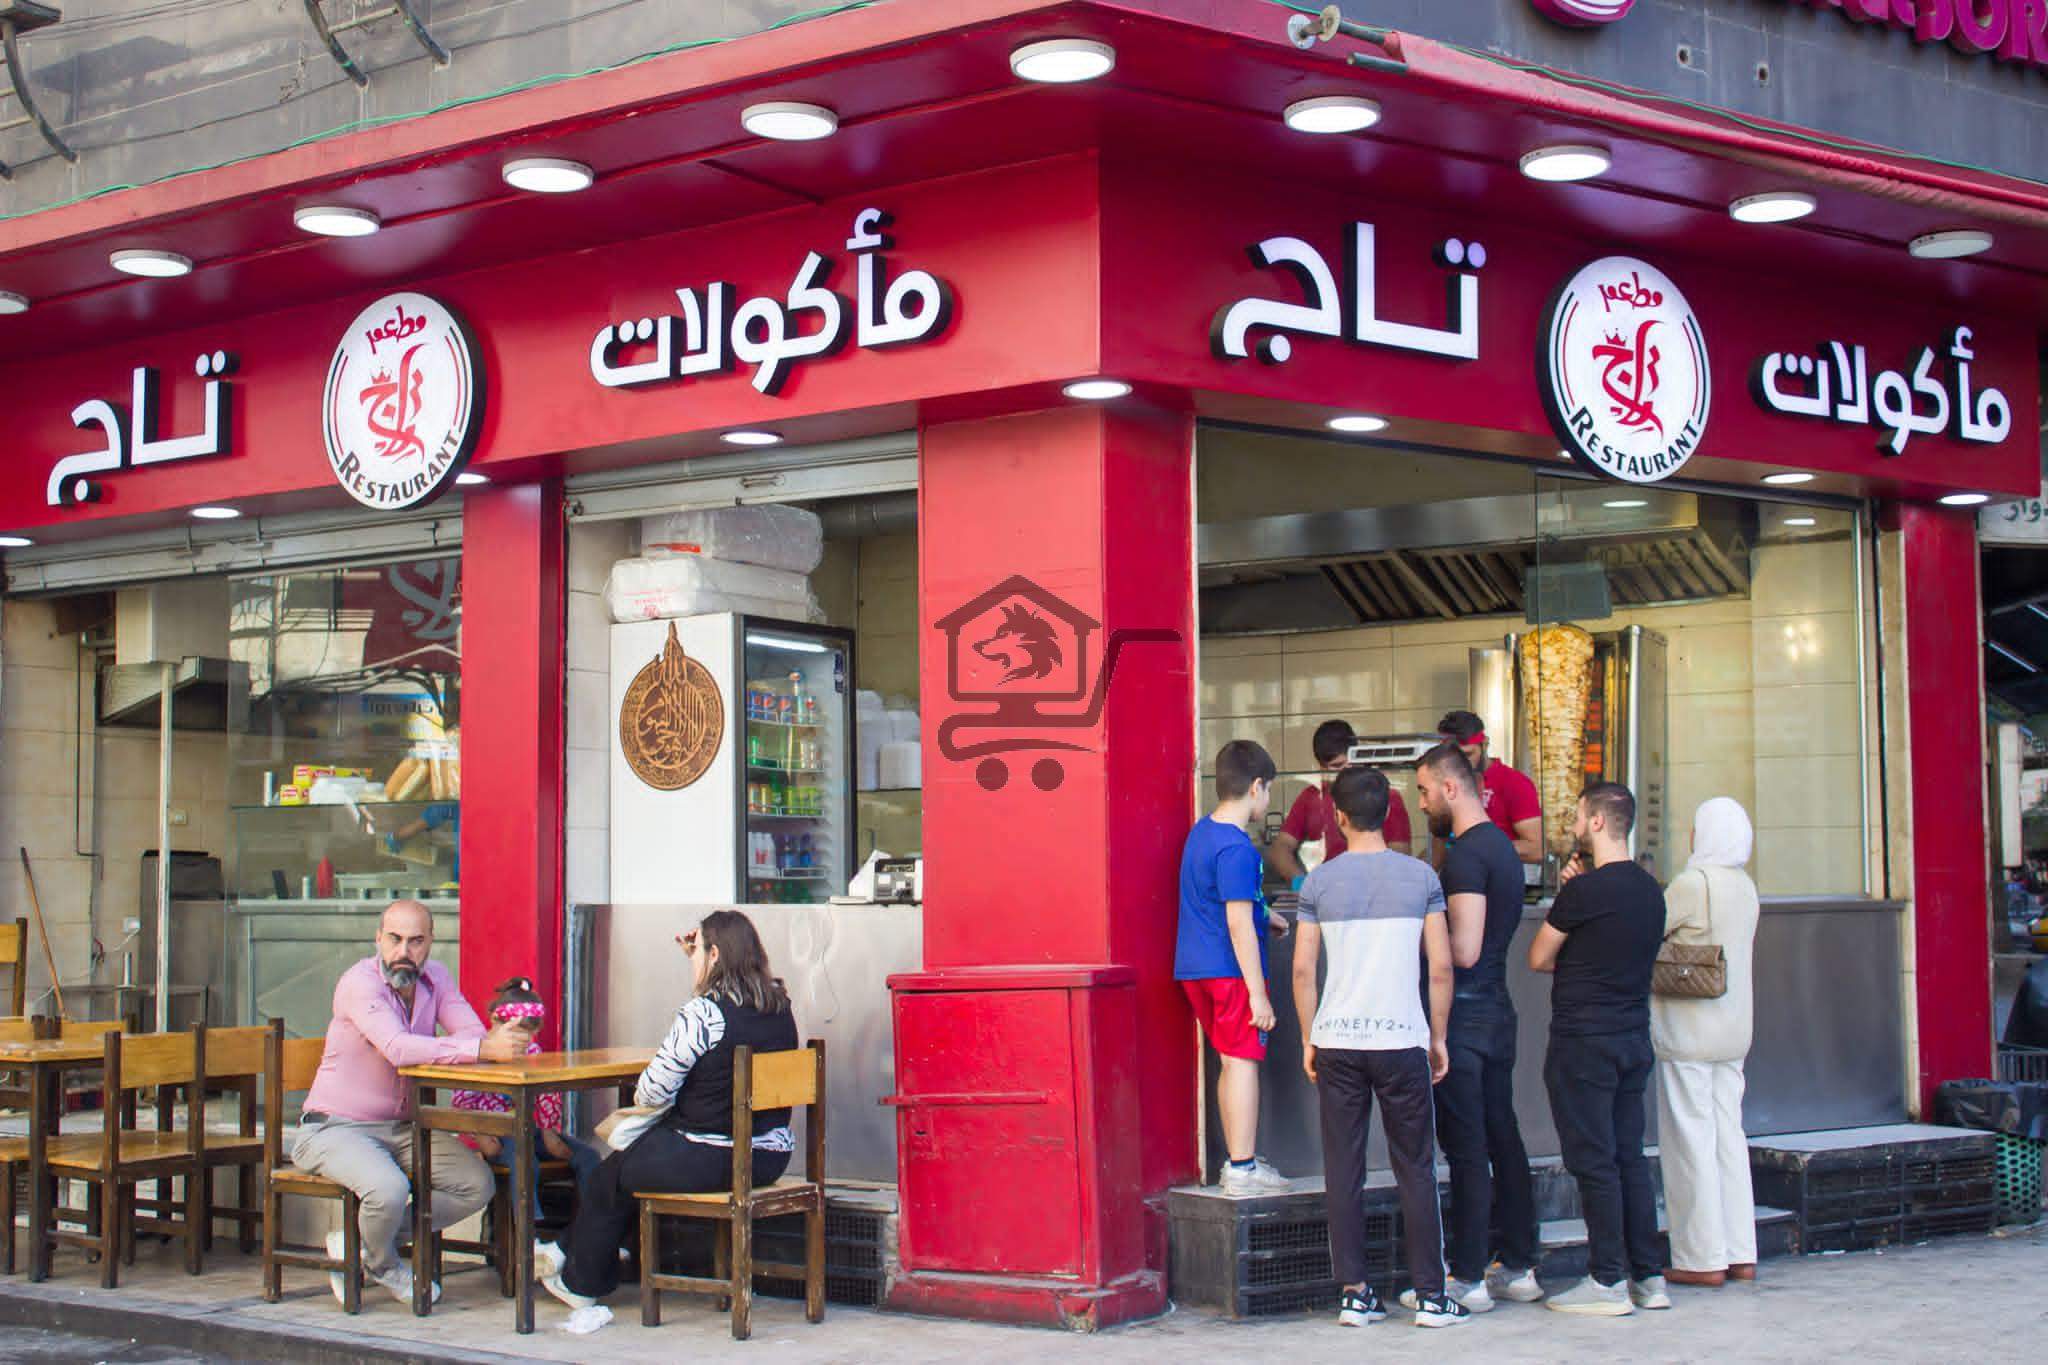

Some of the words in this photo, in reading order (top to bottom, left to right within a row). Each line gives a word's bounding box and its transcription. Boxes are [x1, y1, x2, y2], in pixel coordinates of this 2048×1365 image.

[365, 304, 427, 354] مطعم
[590, 207, 942, 393] مأكولات
[1222, 221, 1487, 363] تاج
[1598, 272, 1664, 312] مطعم
[47, 350, 226, 506] تاج
[1762, 325, 2012, 455] مأكولات
[338, 430, 460, 503] RESTAURANT
[1569, 406, 1699, 476] RESTAURANT
